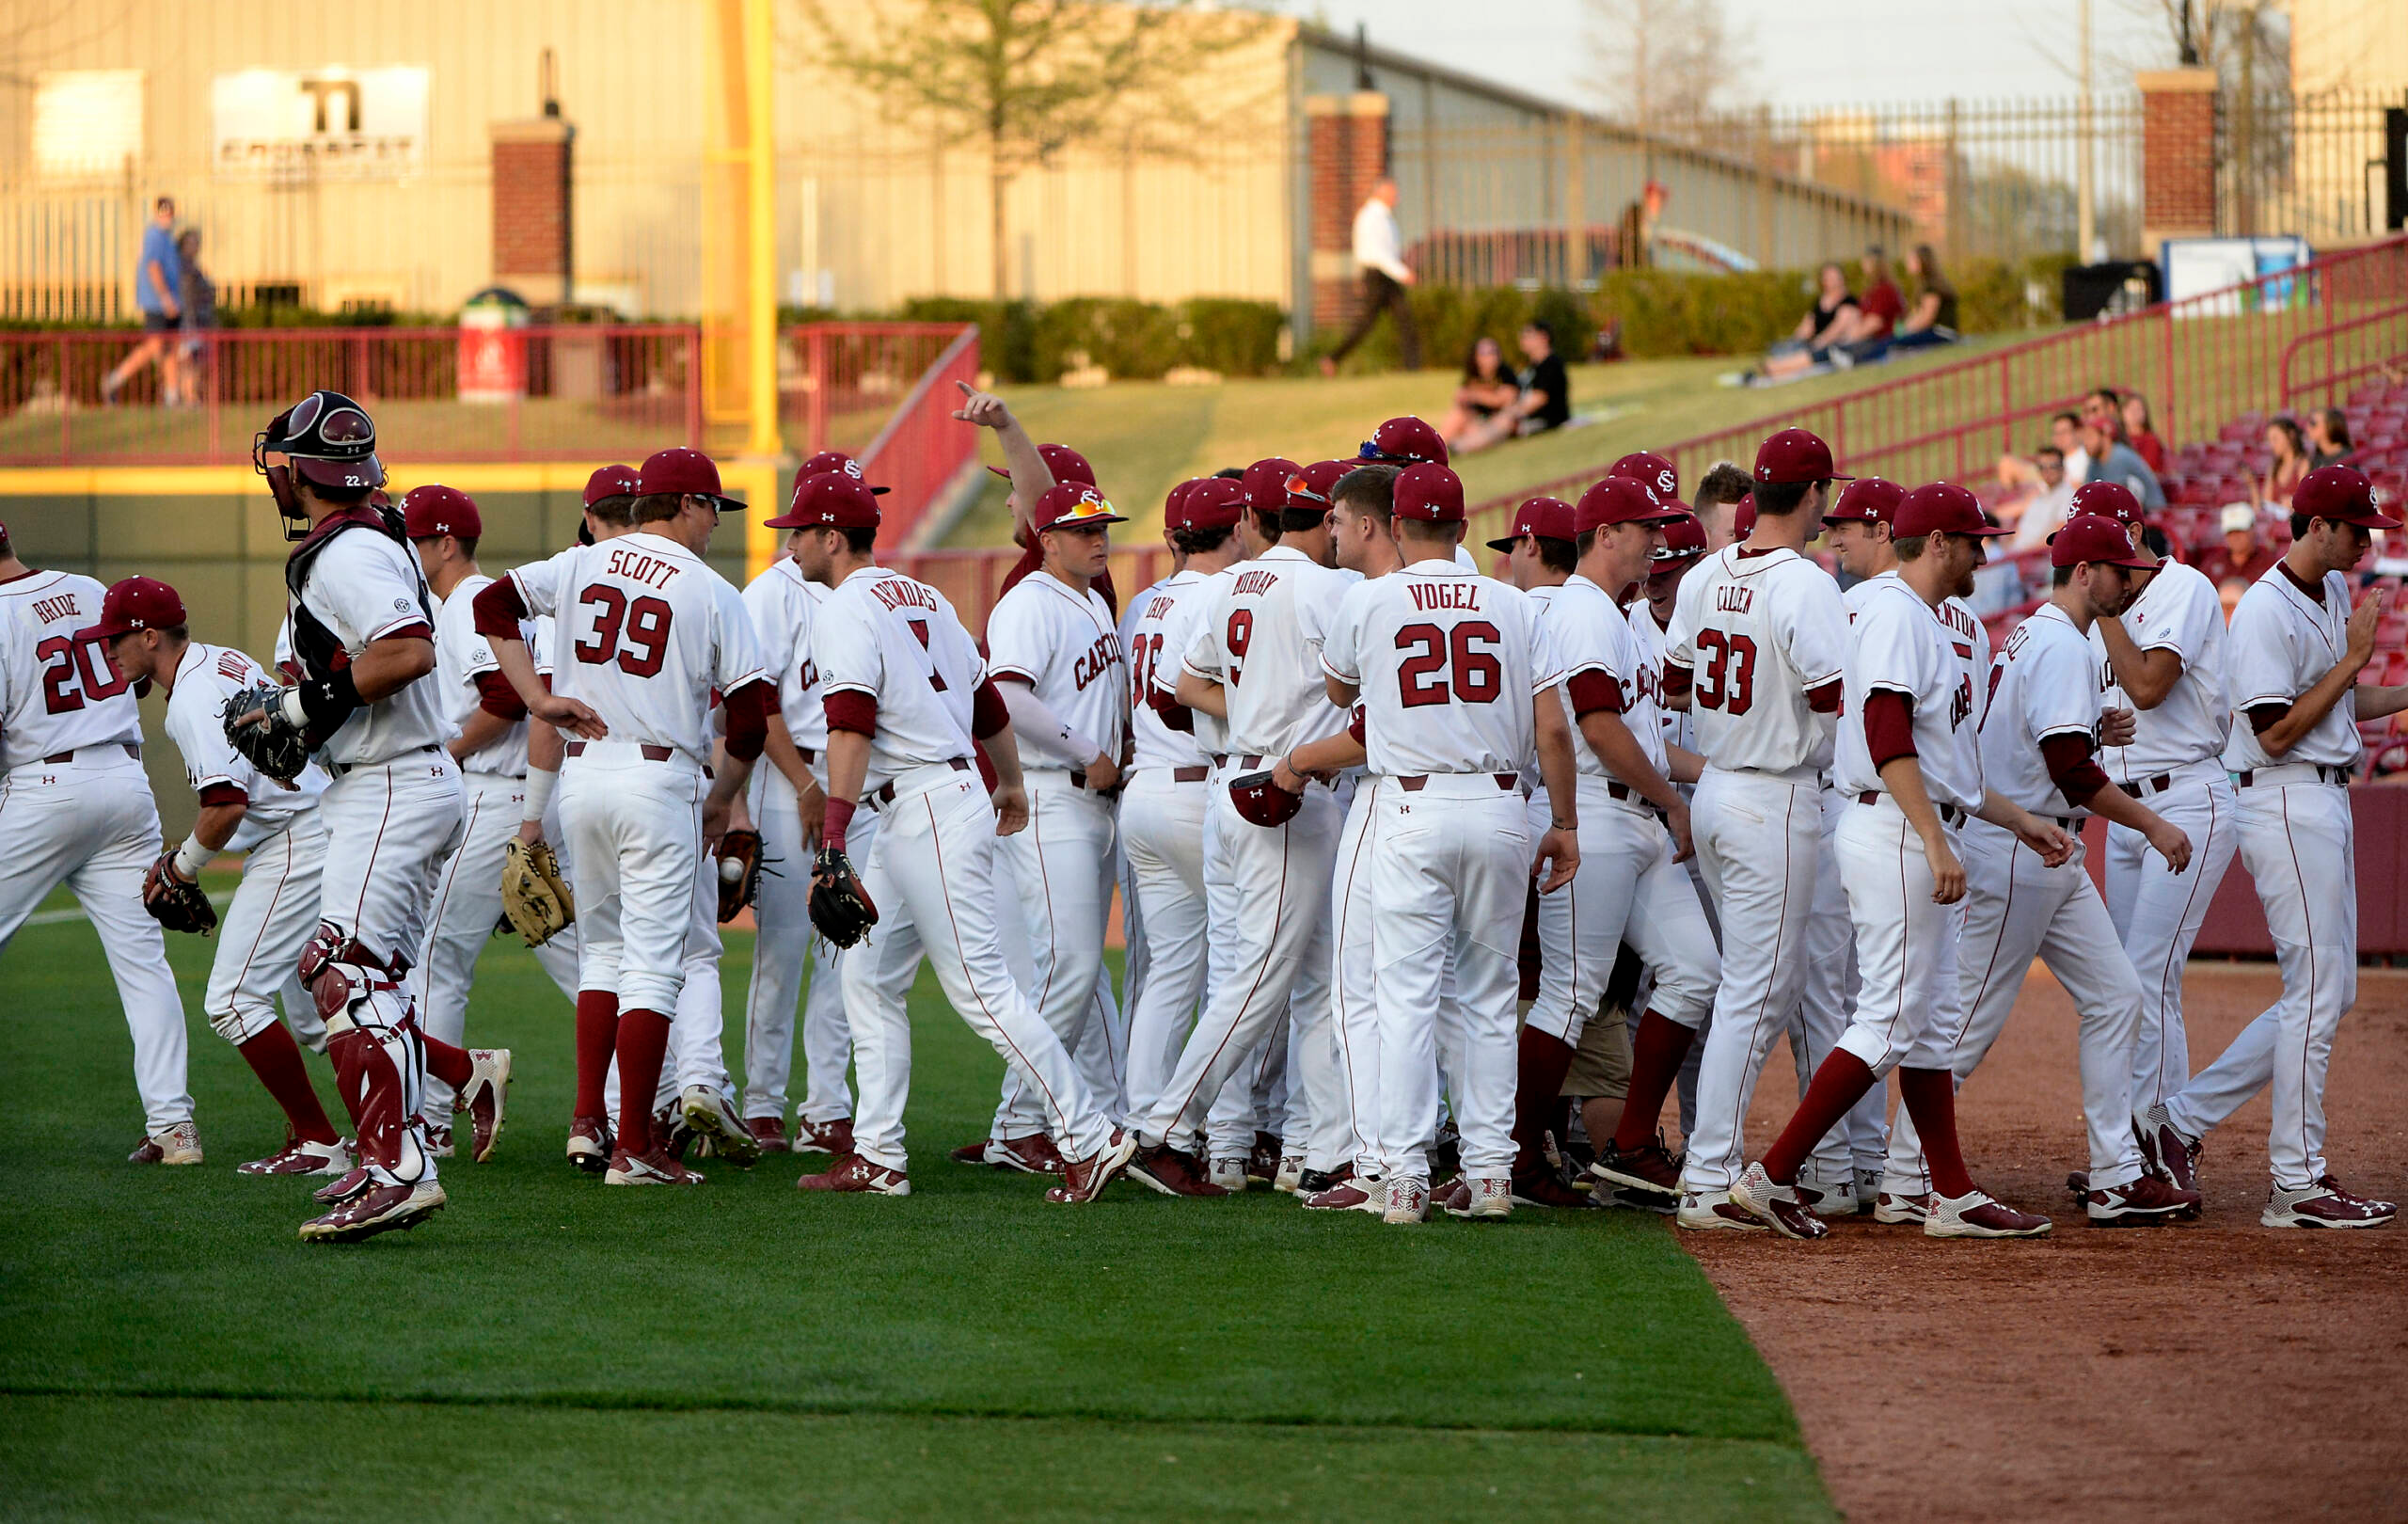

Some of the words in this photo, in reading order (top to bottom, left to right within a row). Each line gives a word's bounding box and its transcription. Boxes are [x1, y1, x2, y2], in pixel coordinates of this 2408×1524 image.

[344, 475, 361, 487] 22
[608, 549, 681, 590] SCOTT
[1231, 570, 1278, 597] MURRAY
[1407, 583, 1481, 612] VOGEL
[32, 593, 81, 626] BRIDE
[575, 583, 673, 679] 39
[35, 634, 131, 716] 20
[1227, 609, 1254, 689] 9
[1394, 620, 1502, 709] 26
[1696, 627, 1758, 717] 33
